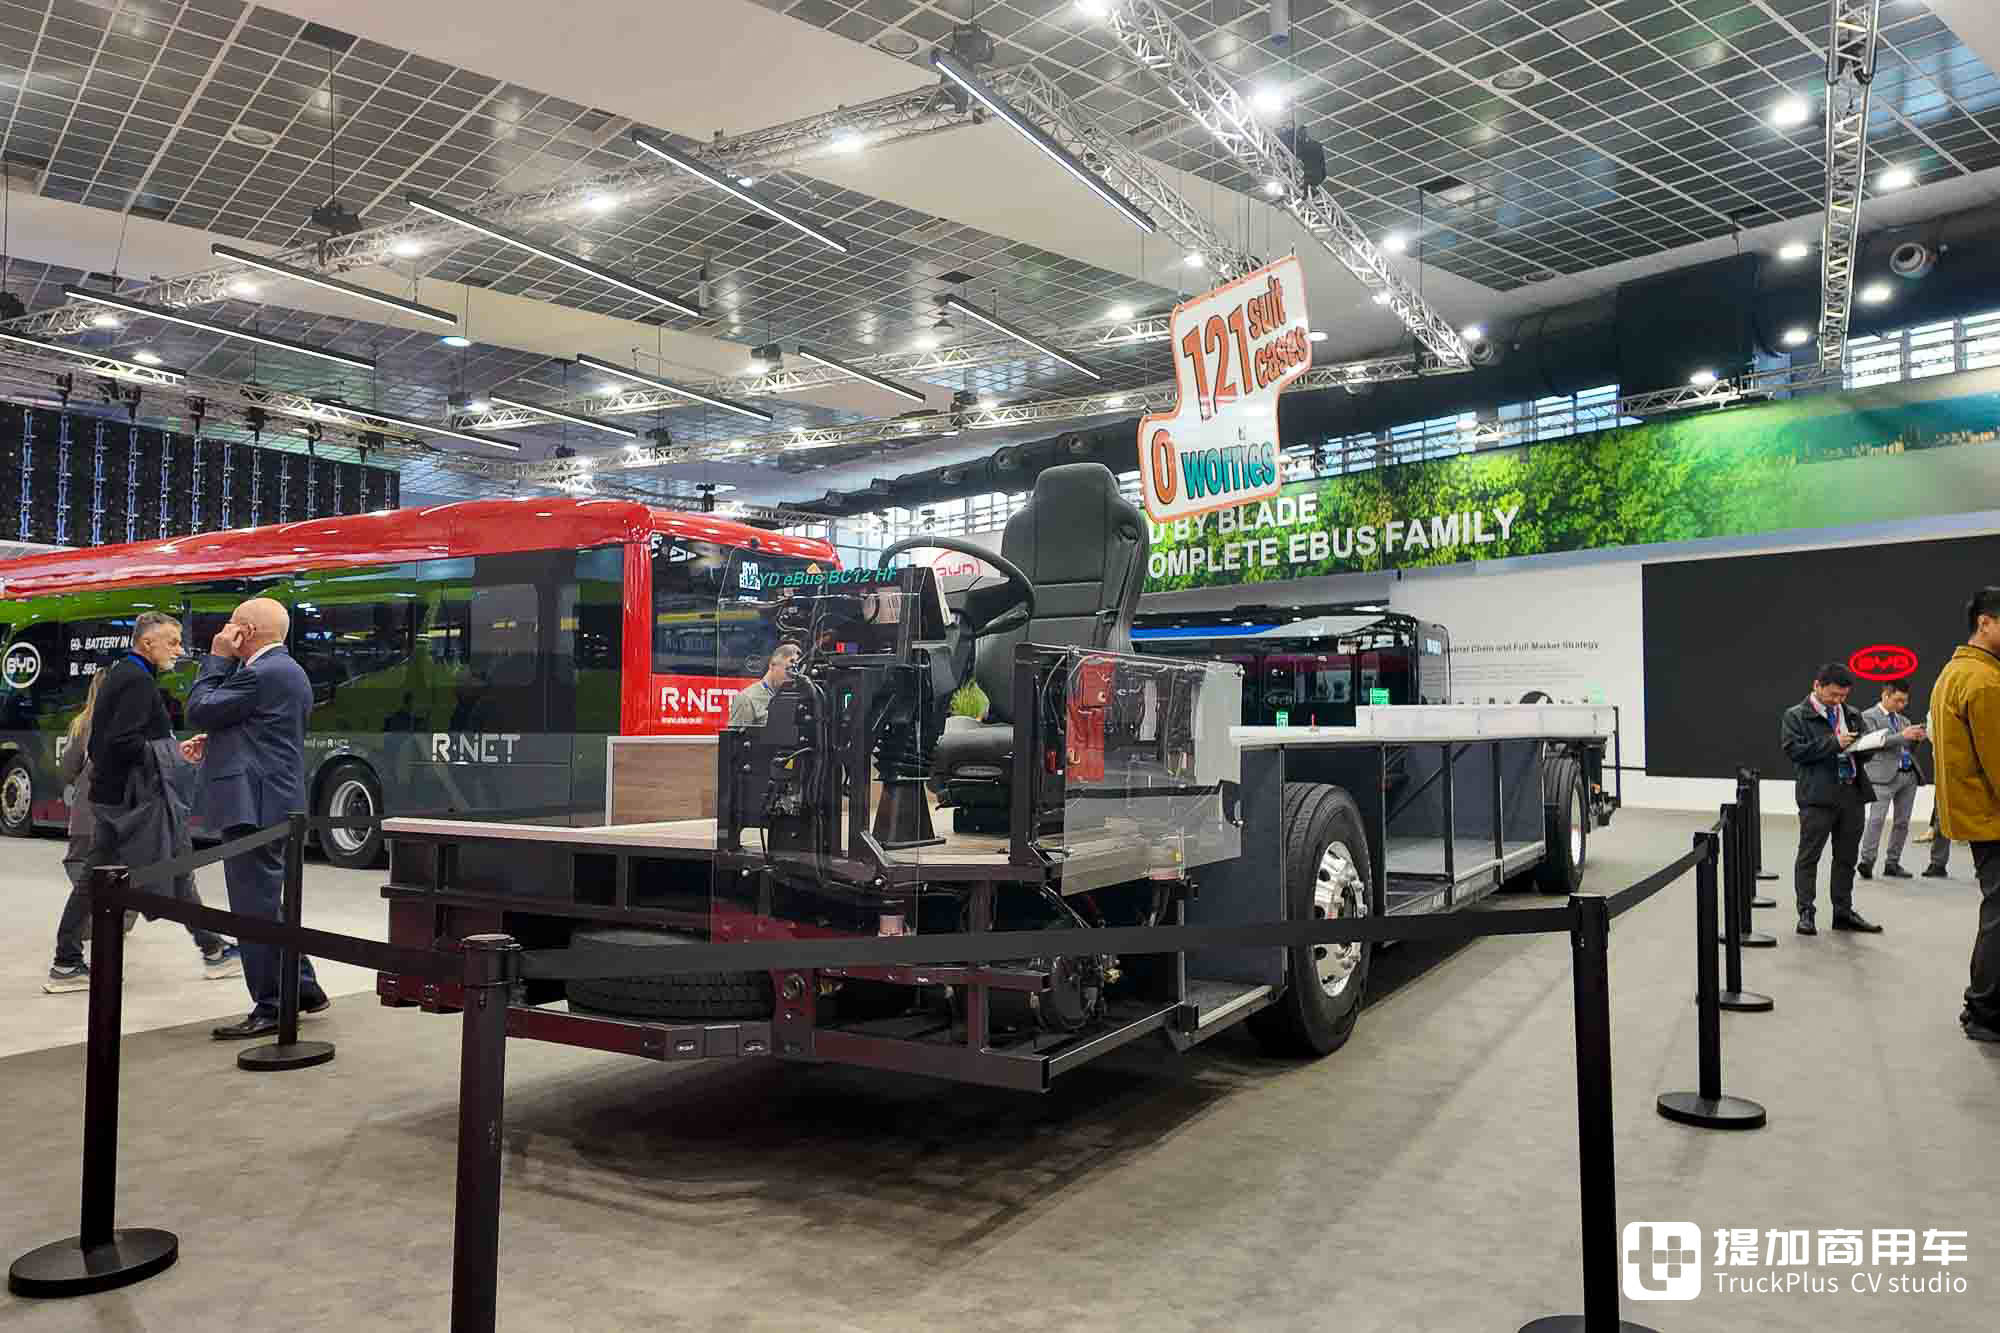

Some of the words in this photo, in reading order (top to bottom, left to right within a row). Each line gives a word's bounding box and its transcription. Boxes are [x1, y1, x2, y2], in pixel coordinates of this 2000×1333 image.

[1183, 304, 1254, 420] 121
[1248, 276, 1286, 340] suit
[1254, 326, 1308, 389] cases
[1152, 429, 1177, 504] 0
[1181, 442, 1276, 500] worries
[1148, 537, 1278, 578] OMPLETE
[1288, 525, 1376, 563] EBUS
[1385, 506, 1519, 553] FAMILY
[1174, 513, 1208, 541] BY
[1217, 493, 1317, 535] BLADE
[759, 572, 779, 587] YD
[783, 571, 823, 586] eBus
[7, 655, 36, 673] BYD
[85, 636, 120, 650] BATTERY
